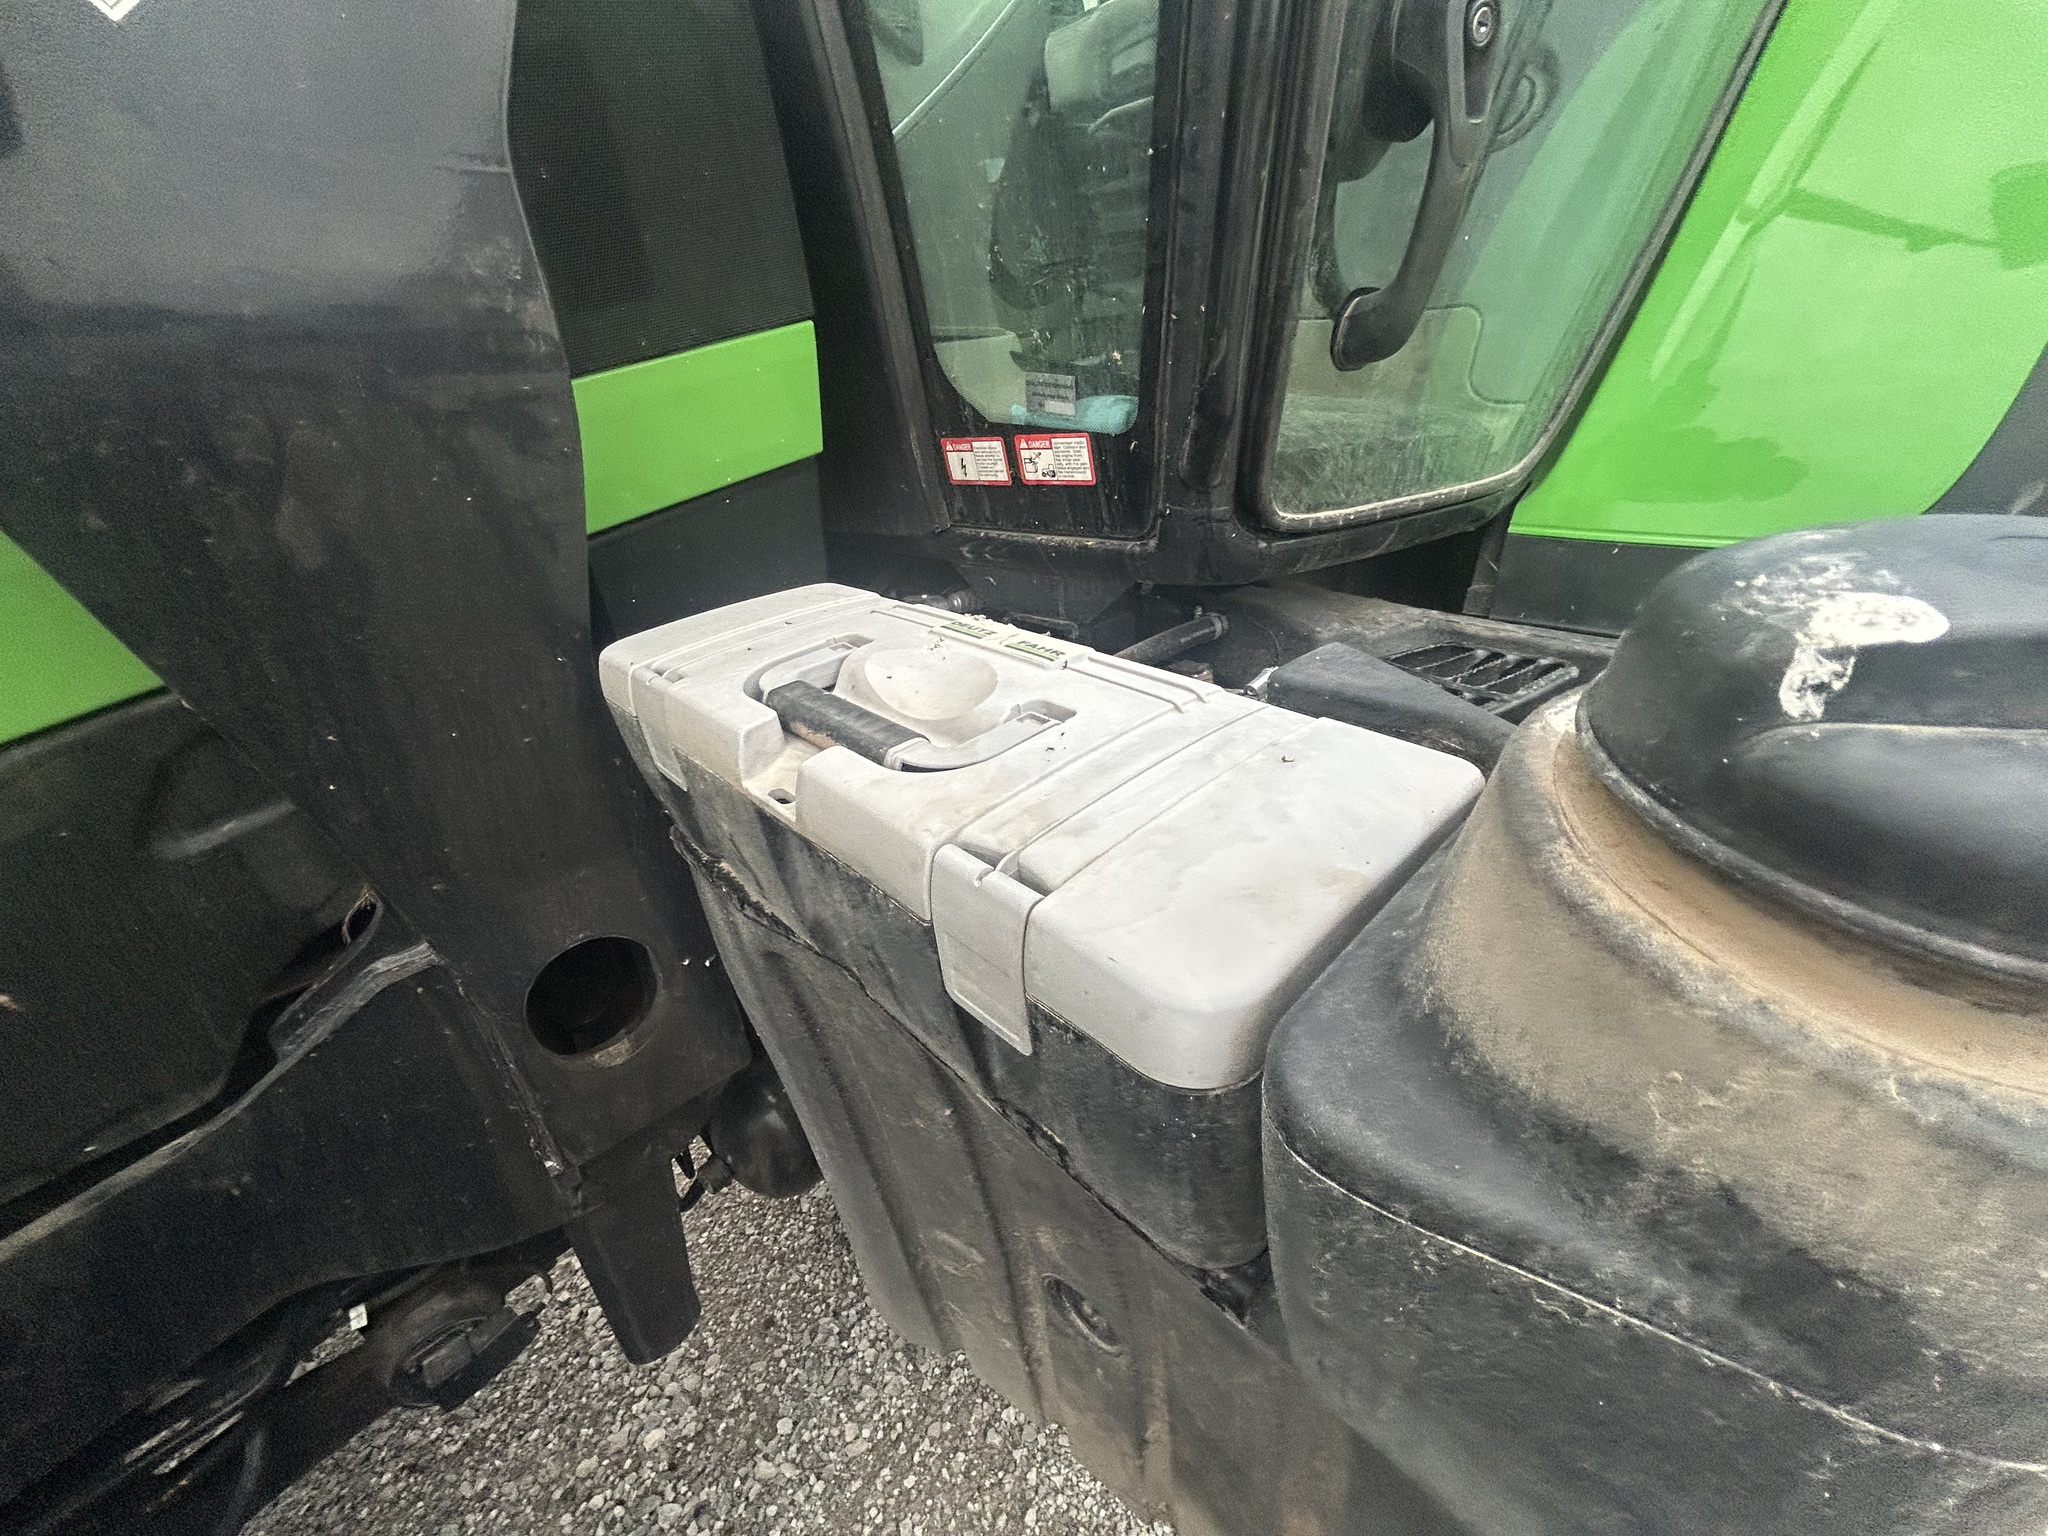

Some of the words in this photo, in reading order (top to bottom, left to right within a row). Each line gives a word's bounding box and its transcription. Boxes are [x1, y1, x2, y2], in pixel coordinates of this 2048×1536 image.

[1027, 440, 1051, 449] DANGER
[950, 620, 998, 636] DEUTZ
[1017, 640, 1066, 657] FAHR
